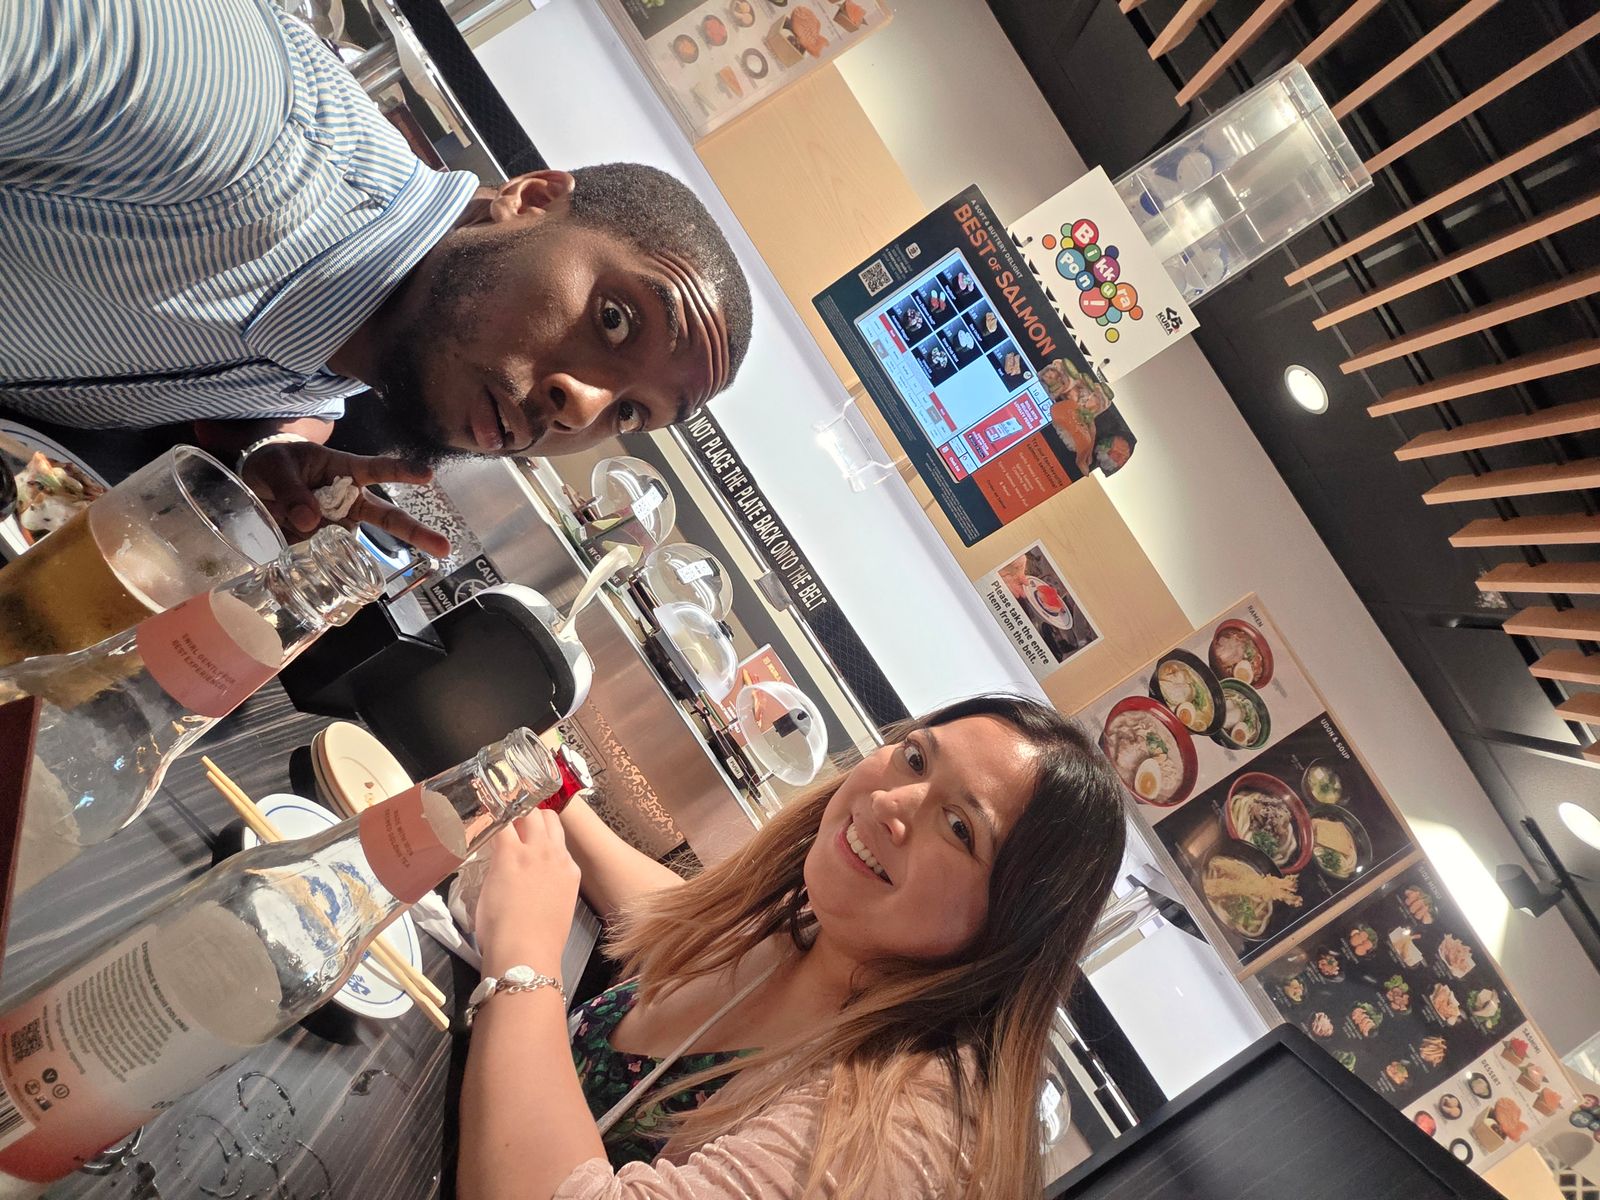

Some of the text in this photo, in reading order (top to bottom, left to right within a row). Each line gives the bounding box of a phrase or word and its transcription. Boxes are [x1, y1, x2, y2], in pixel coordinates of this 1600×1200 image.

[974, 204, 987, 221] SOFT
[986, 225, 1007, 253] BUTTERY
[1003, 253, 1023, 278] DELIGHT
[952, 203, 1058, 356] BEST OF SALMON
[1157, 311, 1174, 334] KURA
[687, 415, 716, 444] NOT
[700, 435, 735, 474] PLACE
[720, 465, 748, 493] THE
[732, 484, 767, 522] PLATE
[751, 513, 784, 547] BACK
[587, 546, 597, 556] NY
[768, 538, 800, 572] ONTO
[785, 563, 812, 590] THE
[797, 582, 827, 613] BELT
[986, 590, 1038, 664] item from the belt.
[990, 579, 1051, 665] Please take the entire
[1246, 604, 1263, 627] RAMEN
[170, 638, 187, 657] BEST
[180, 632, 200, 655] SWIRL
[196, 653, 222, 677] GENTLY
[1320, 718, 1335, 737] UDON
[1335, 741, 1350, 760] SOUP
[729, 760, 740, 774] PUSH
[400, 856, 410, 868] TEA
[1417, 865, 1442, 900] SIDE MENU
[142, 940, 191, 1032] EXPERIENCE MOSHI OOLONG
[1521, 1027, 1541, 1054] SASHIMI
[1480, 1058, 1501, 1087] DESSERT
